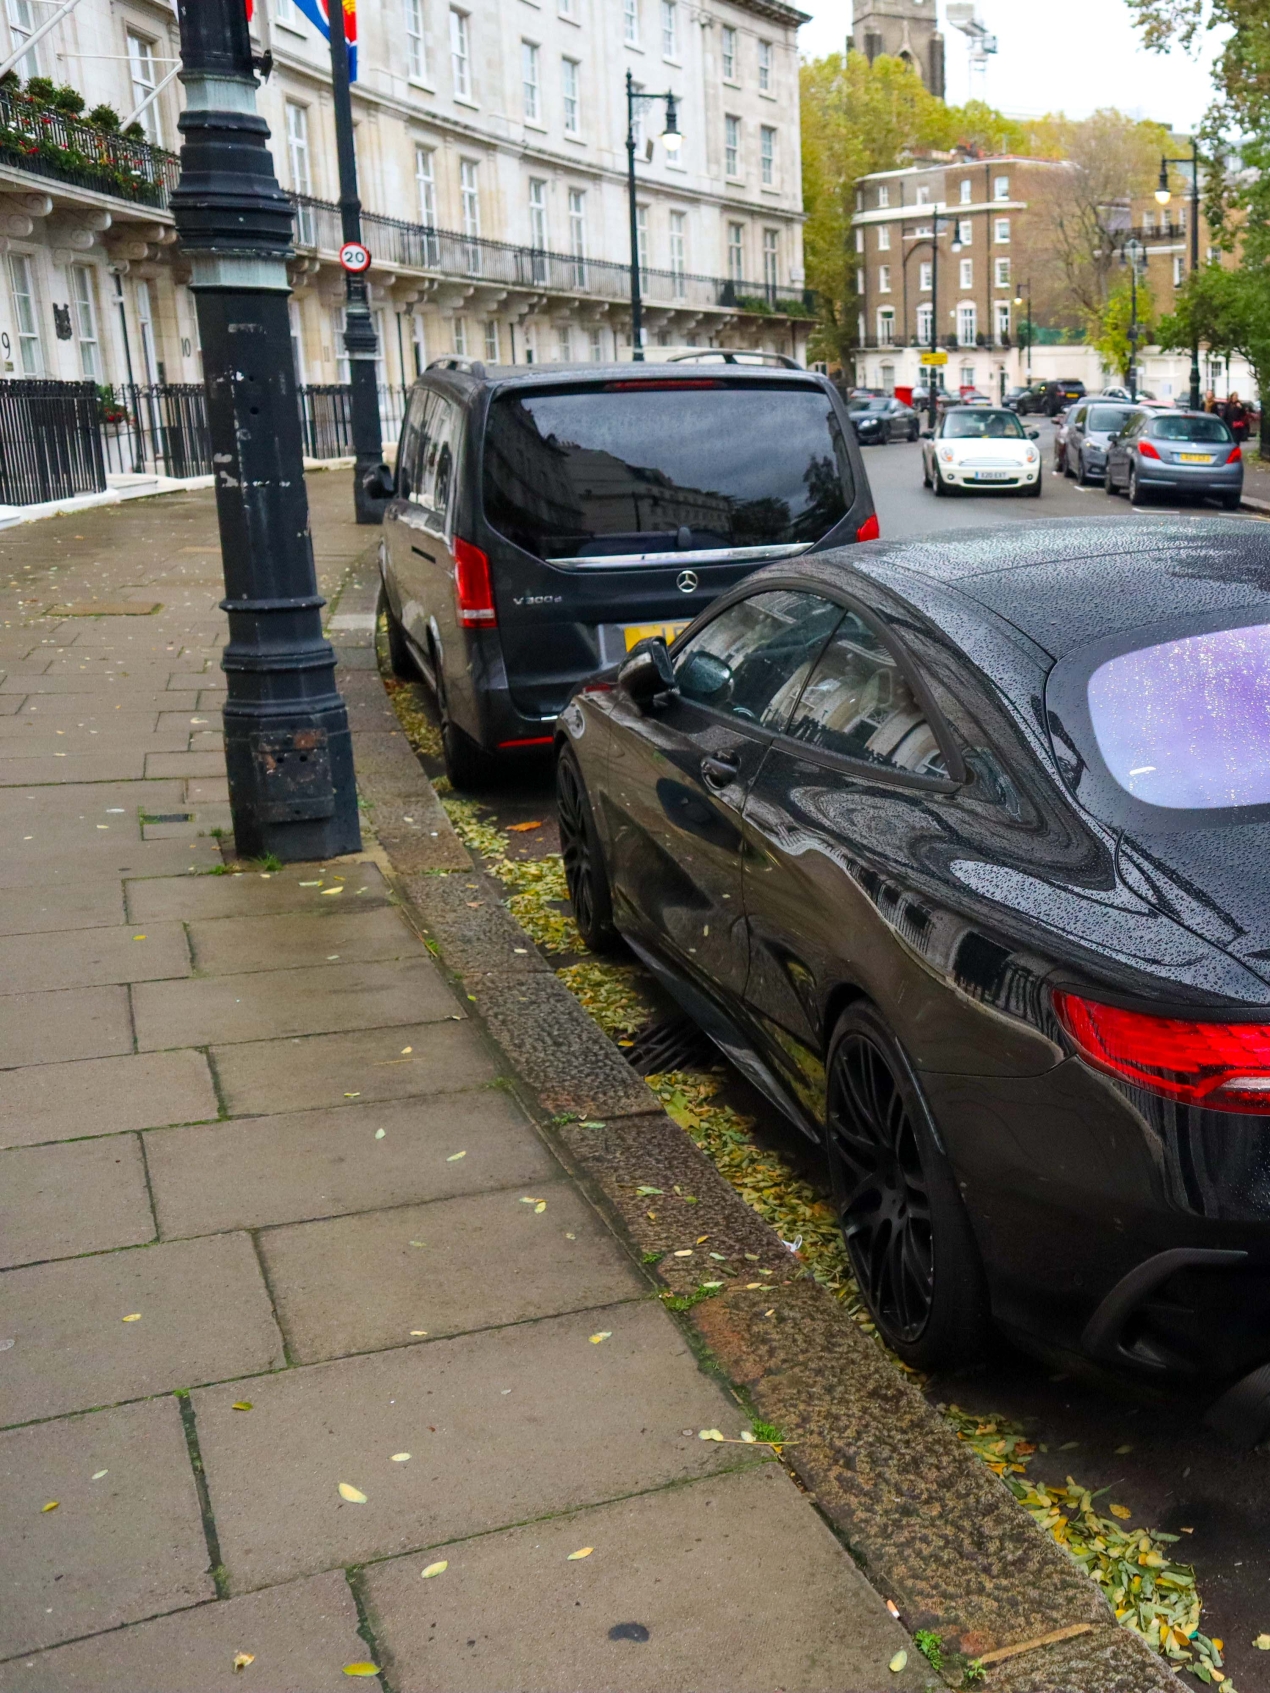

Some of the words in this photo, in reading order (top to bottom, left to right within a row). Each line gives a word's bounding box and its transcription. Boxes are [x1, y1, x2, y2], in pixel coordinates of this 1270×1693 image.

[344, 251, 365, 263] 20
[1, 332, 11, 360] 9
[180, 337, 192, 358] 10
[513, 597, 524, 605] V
